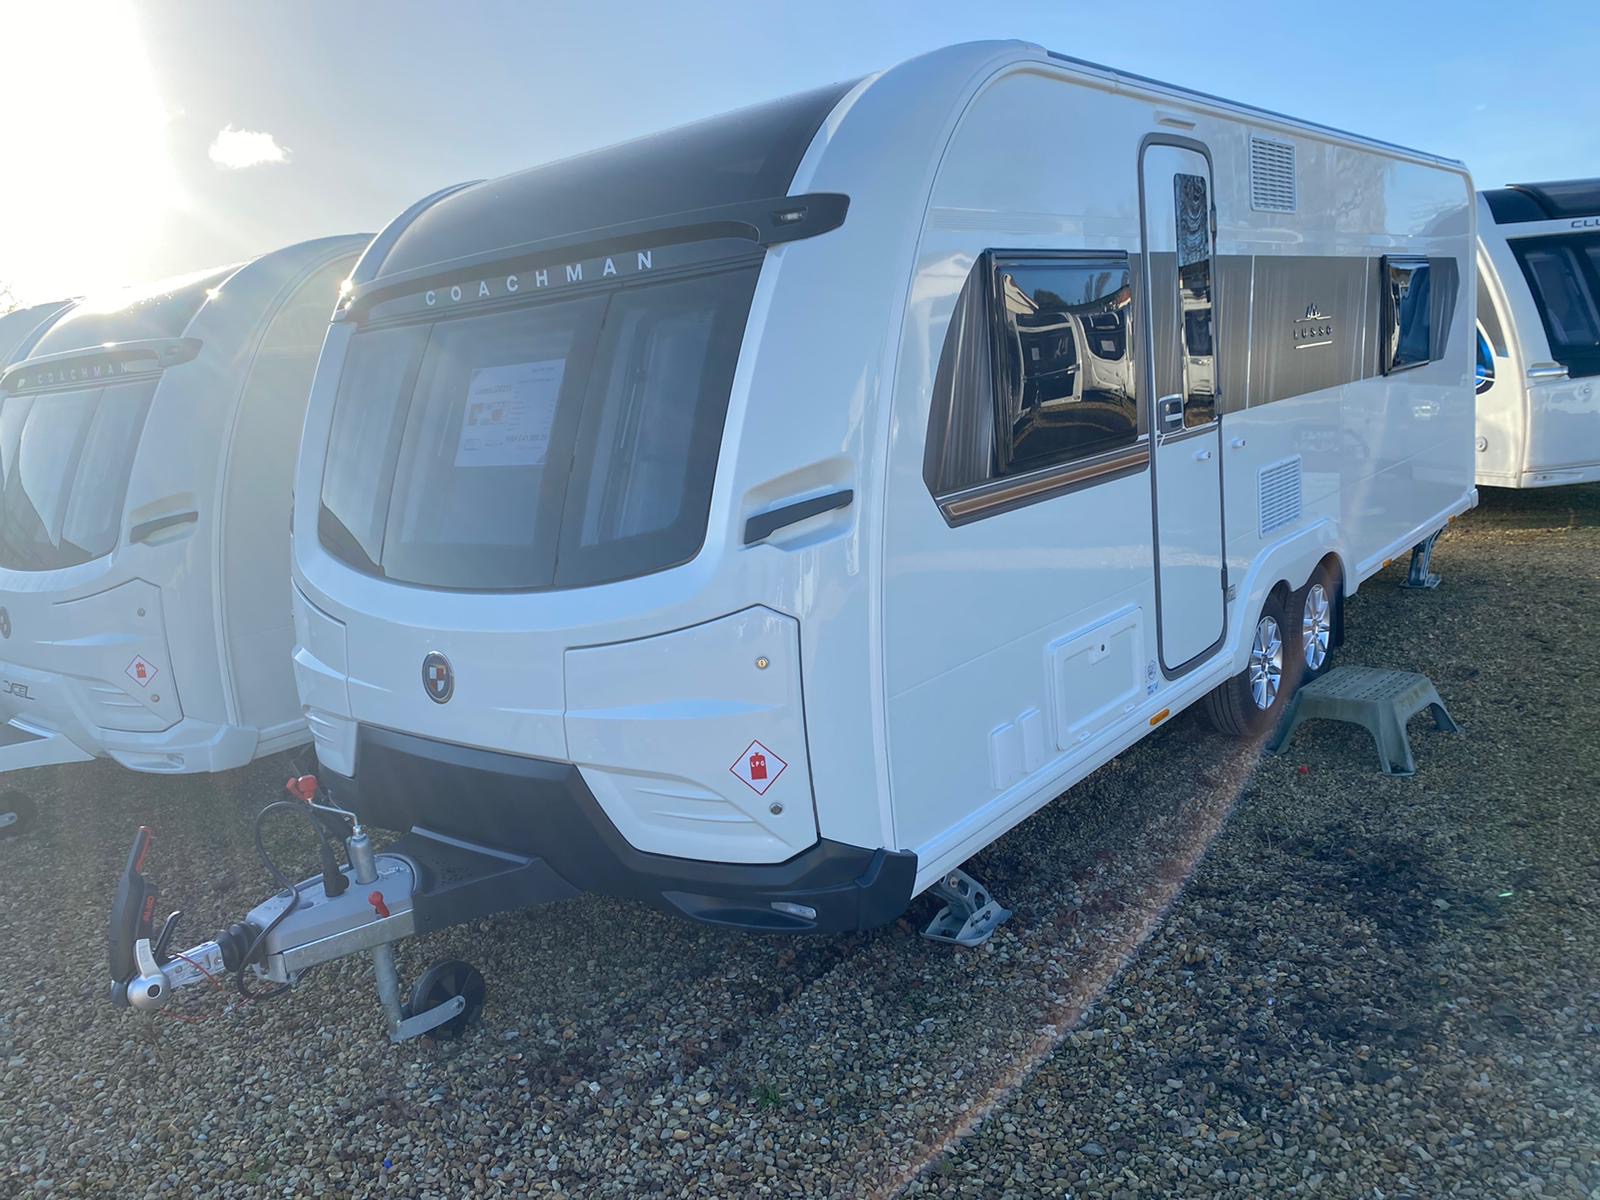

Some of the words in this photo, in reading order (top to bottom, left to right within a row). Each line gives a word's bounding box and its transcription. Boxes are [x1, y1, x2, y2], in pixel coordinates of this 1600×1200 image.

[425, 250, 653, 306] COACHMAN
[1293, 324, 1333, 341] LUSSO
[37, 361, 129, 385] COACHMAN
[751, 760, 765, 768] LPG
